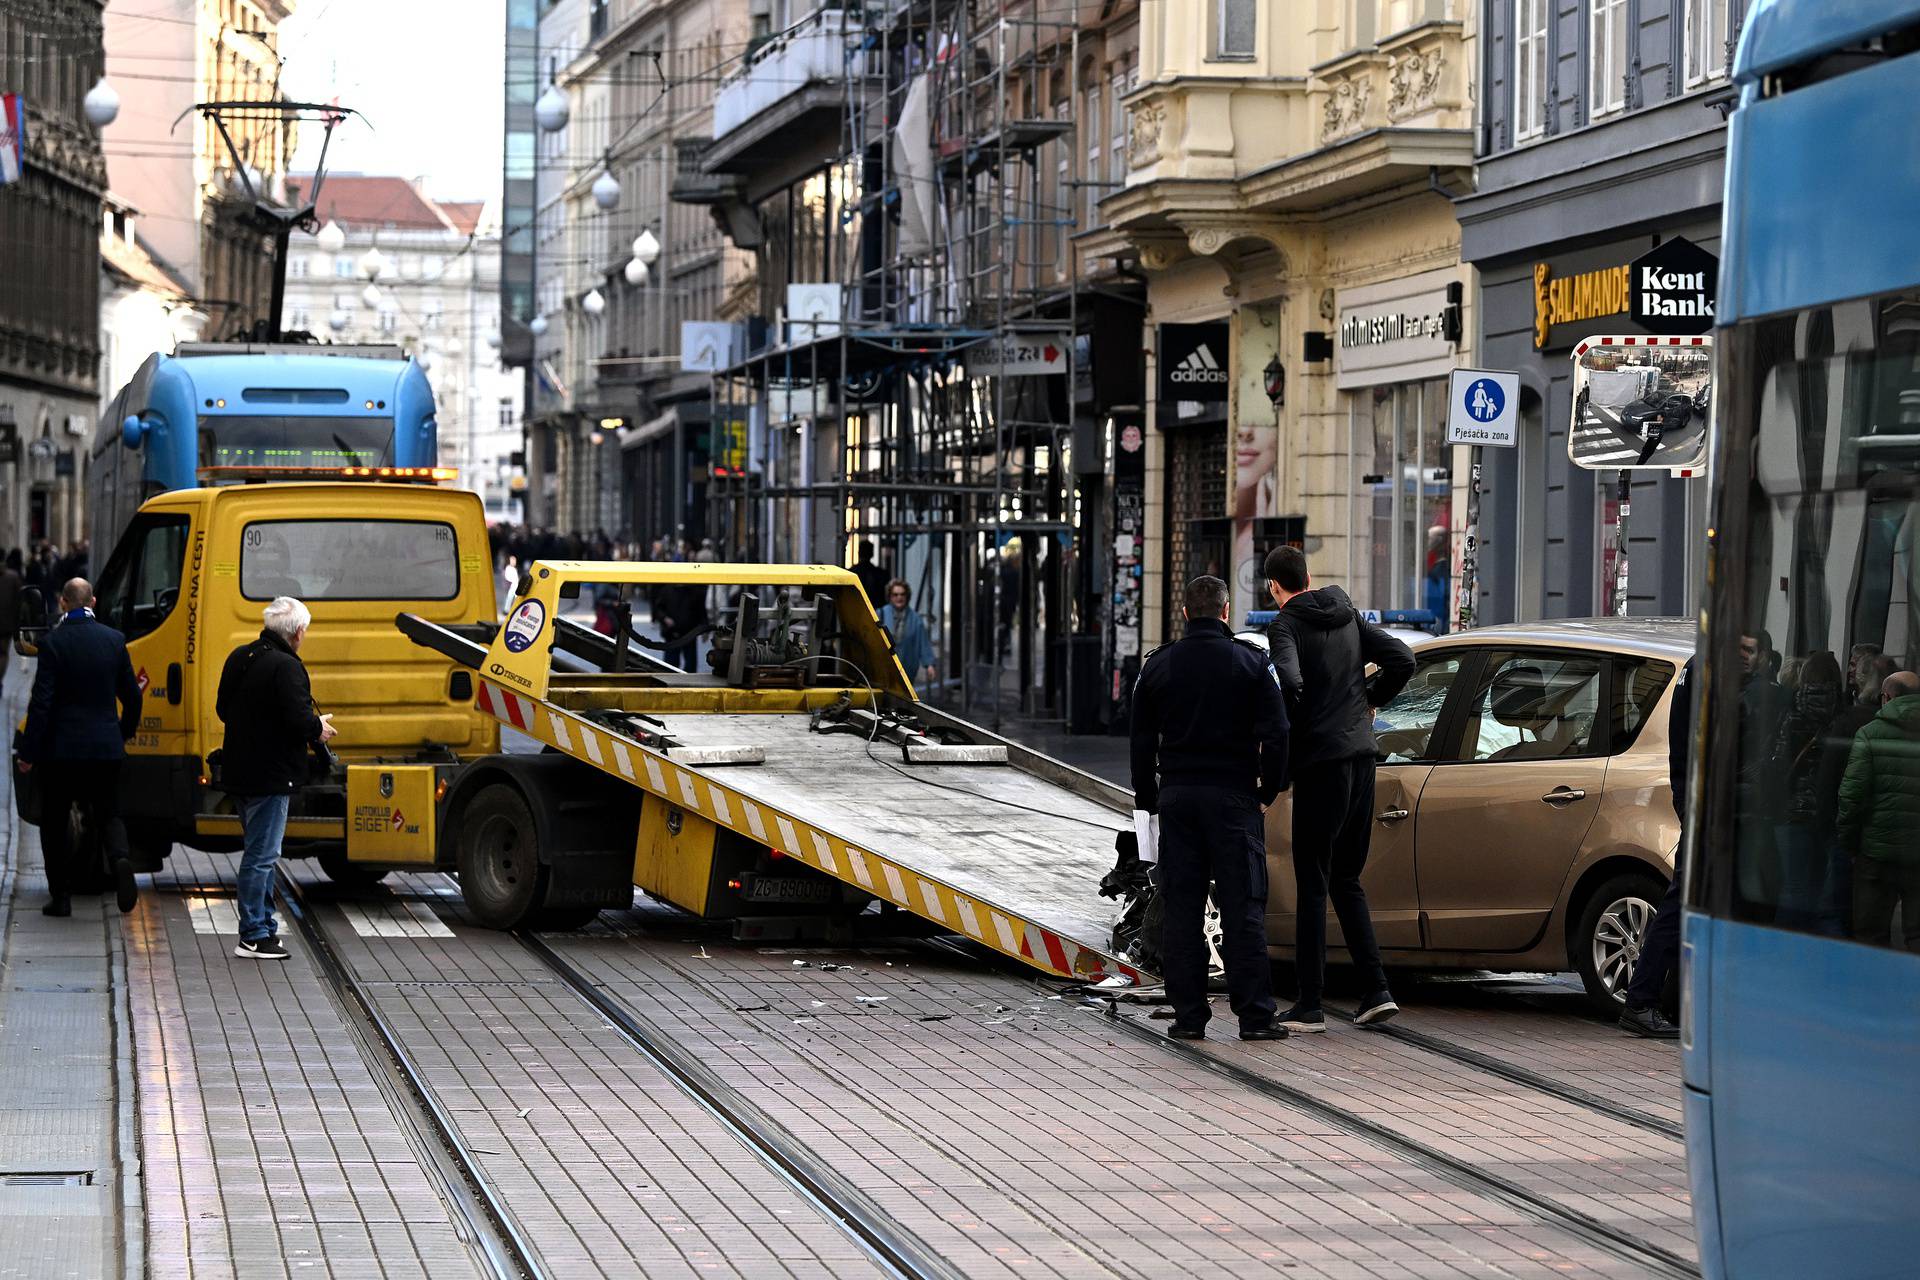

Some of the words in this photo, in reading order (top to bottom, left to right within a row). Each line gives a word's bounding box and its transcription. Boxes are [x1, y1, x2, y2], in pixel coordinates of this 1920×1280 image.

[1641, 266, 1705, 290] Kent
[1550, 264, 1629, 325] SALAMANDE
[1641, 292, 1715, 316] Bank
[1341, 313, 1404, 348] intimissimi
[1170, 368, 1228, 382] adidas
[1455, 427, 1489, 440] Pješačka
[1491, 431, 1509, 440] zona
[246, 529, 262, 546] 90
[435, 527, 449, 541] HR
[193, 530, 205, 571] CESTI
[191, 574, 200, 598] NA
[503, 670, 532, 688] TISCHER
[355, 805, 392, 817] AUTOKLUB
[355, 817, 391, 832] SIGET
